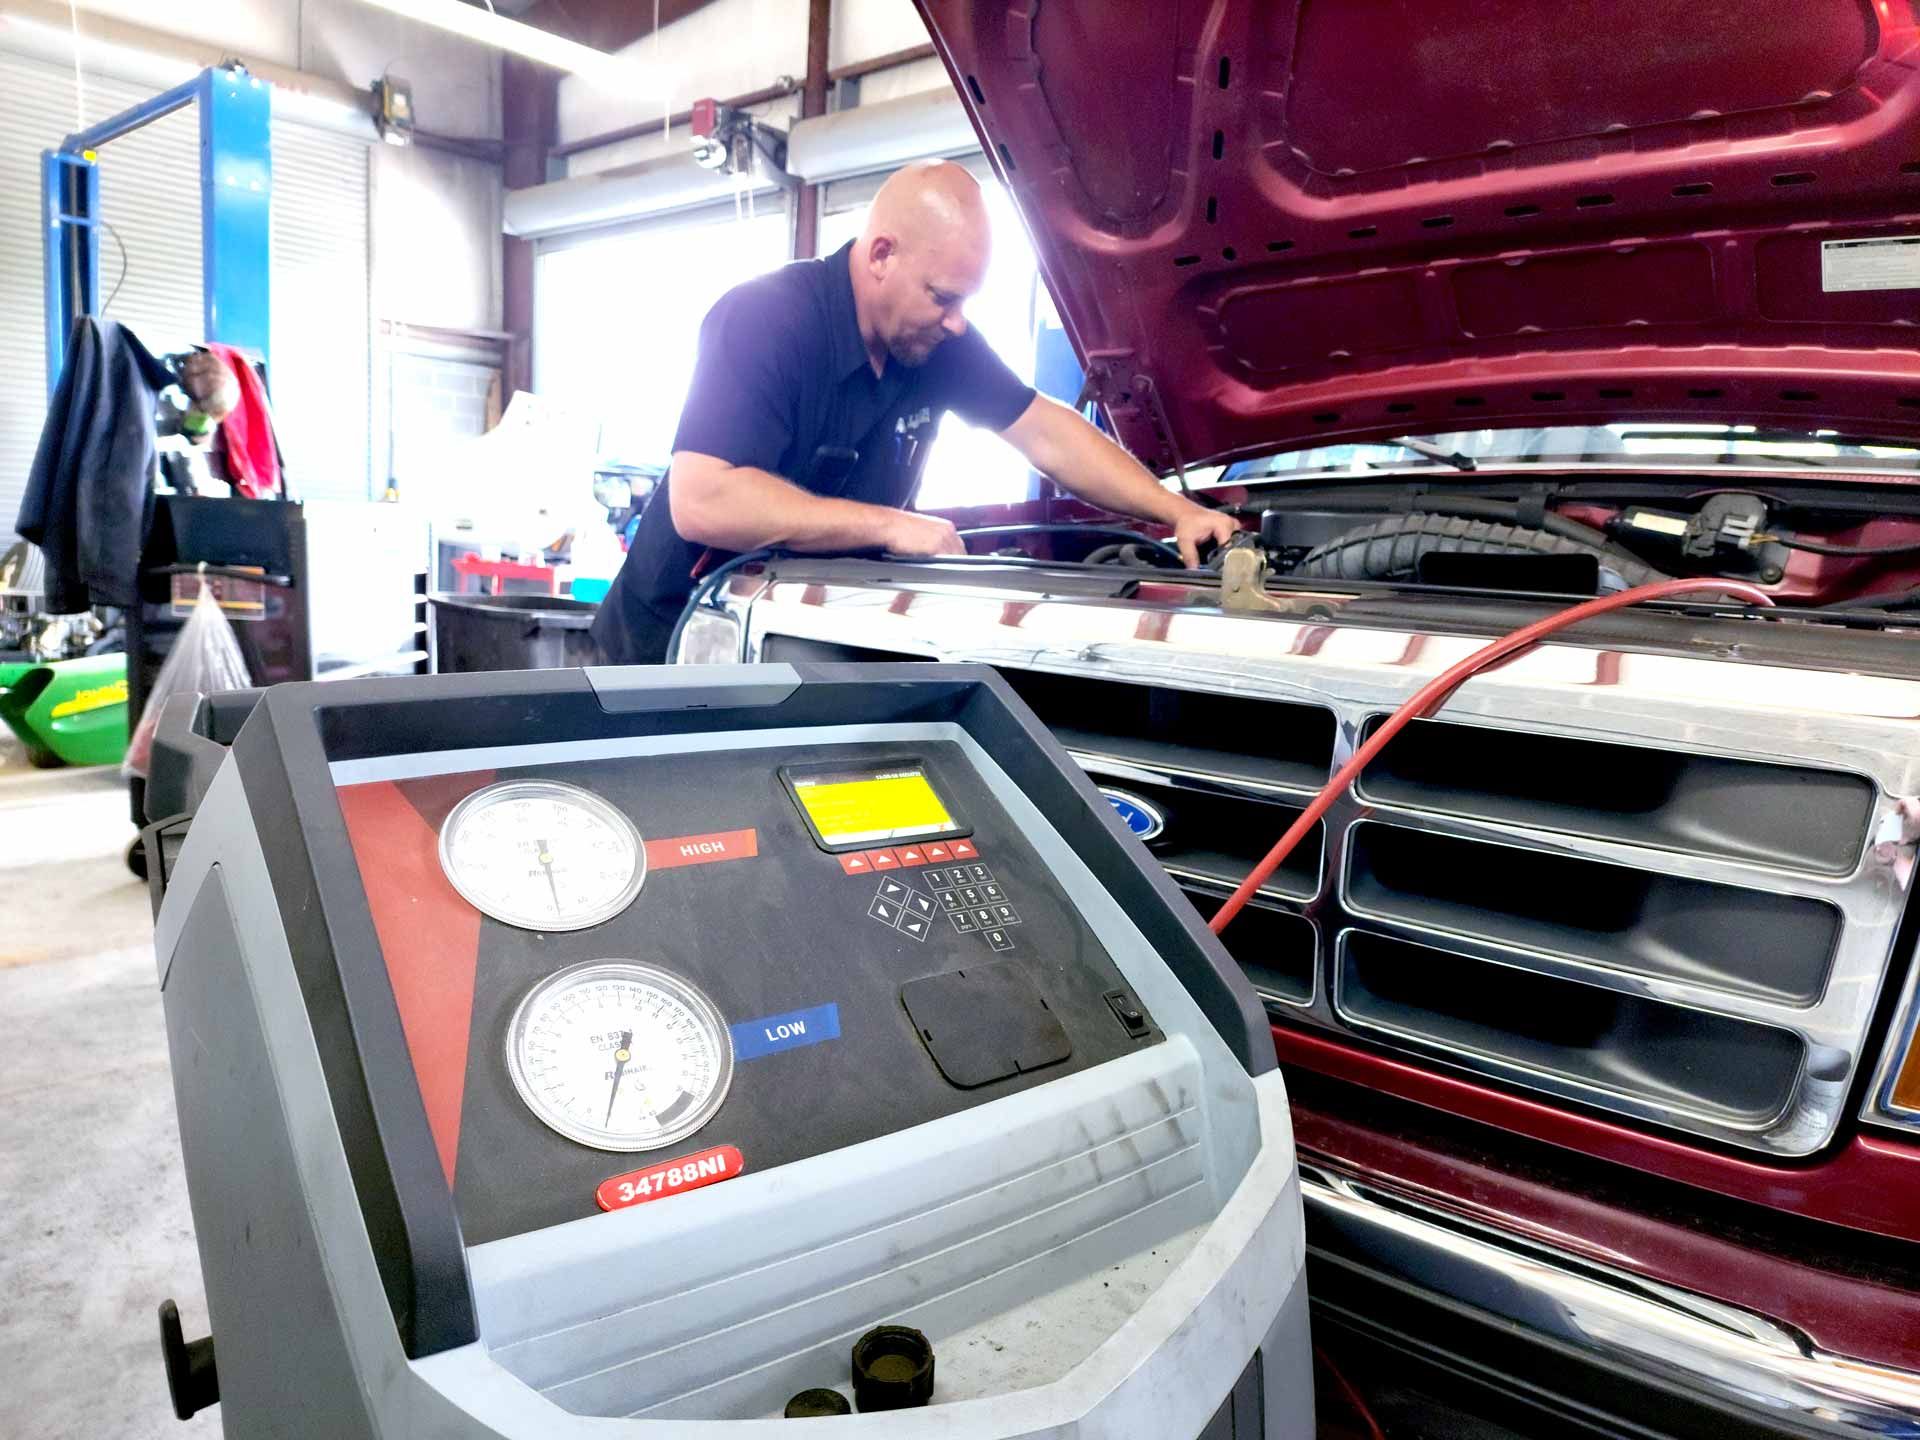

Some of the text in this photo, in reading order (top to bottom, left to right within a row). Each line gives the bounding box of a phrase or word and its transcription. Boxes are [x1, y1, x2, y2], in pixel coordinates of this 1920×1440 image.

[680, 841, 726, 857] HIGH
[953, 870, 963, 878] 2
[975, 867, 984, 875] 3
[932, 873, 940, 882] 1
[966, 889, 975, 898] 5
[987, 886, 996, 895] 6
[945, 893, 953, 901] 4
[979, 910, 988, 920] 8
[1000, 907, 1009, 916] 9
[956, 914, 965, 923] 7
[993, 932, 1002, 942] 0
[765, 1020, 806, 1042] LOW
[617, 1154, 727, 1202] 34788NI
